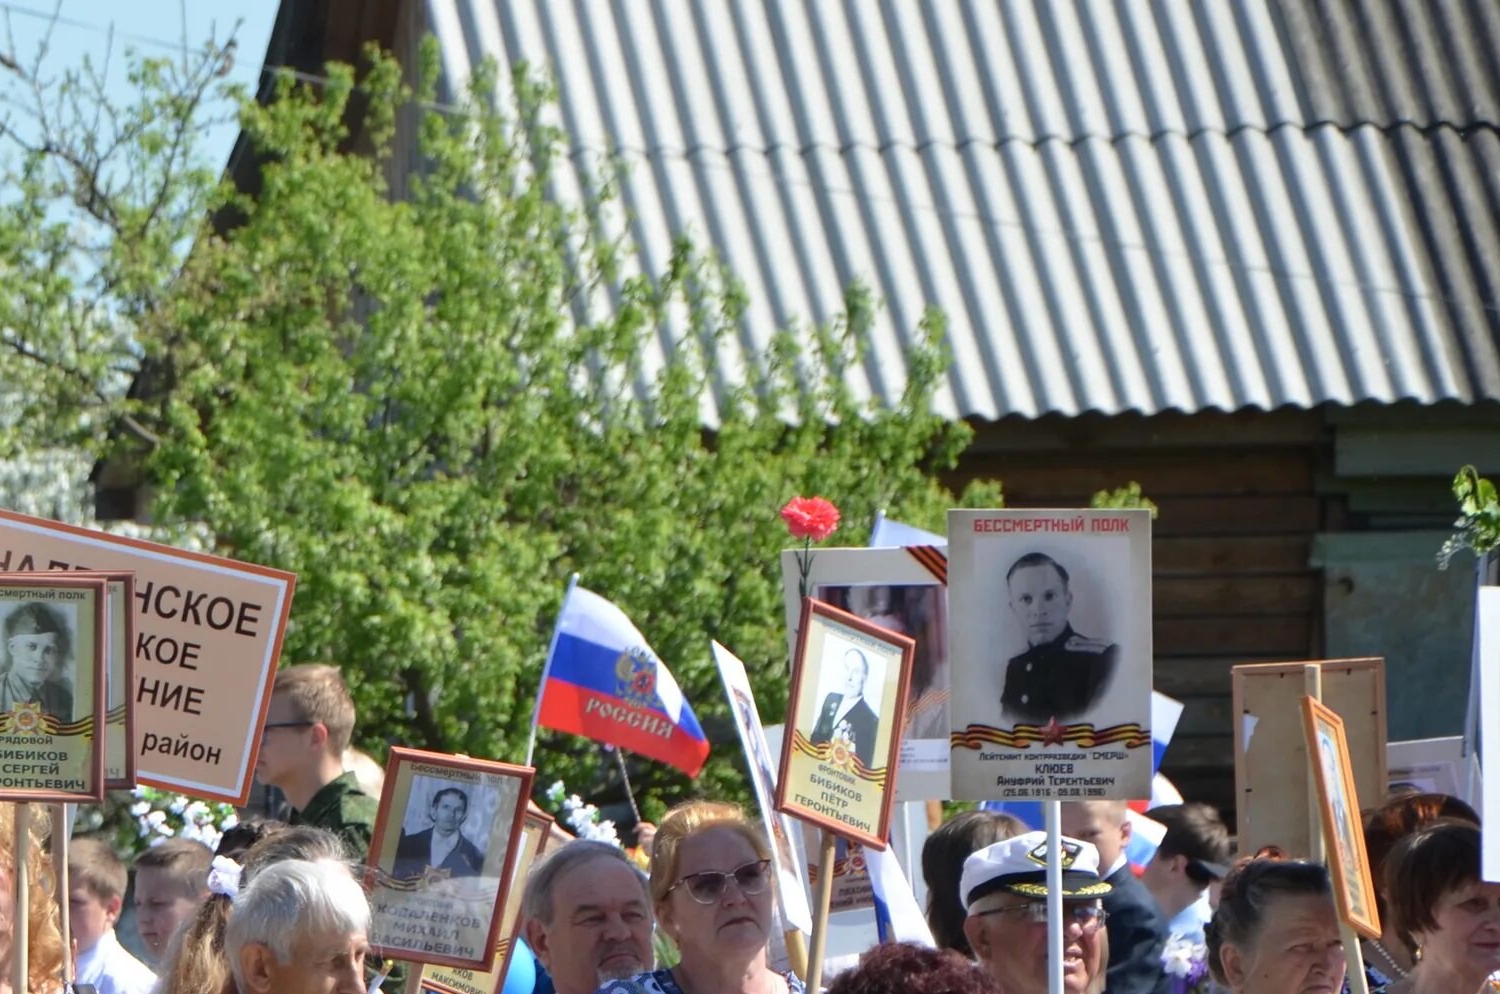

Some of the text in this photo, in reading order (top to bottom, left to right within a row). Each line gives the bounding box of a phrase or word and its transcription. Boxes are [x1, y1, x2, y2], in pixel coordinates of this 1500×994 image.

[974, 517, 1130, 532] БЕССМЕРТНЫЙ ПОЛК
[58, 590, 86, 600] полк
[585, 697, 675, 739] РОССИЯ
[141, 732, 222, 765] район
[2, 763, 60, 775] СЕРГЕЙ
[1035, 764, 1074, 775] КЛЮЕВ
[810, 774, 863, 802] БИБИКОВ
[820, 790, 849, 809] ПЁТР
[794, 793, 871, 832] ГЕРОНТЬЕВИЧ
[377, 904, 482, 929] КОВАЛЕНКОВ
[393, 921, 461, 940] МИХАИЛ
[372, 933, 475, 958] ВАСИЛЬЕВИЧ
